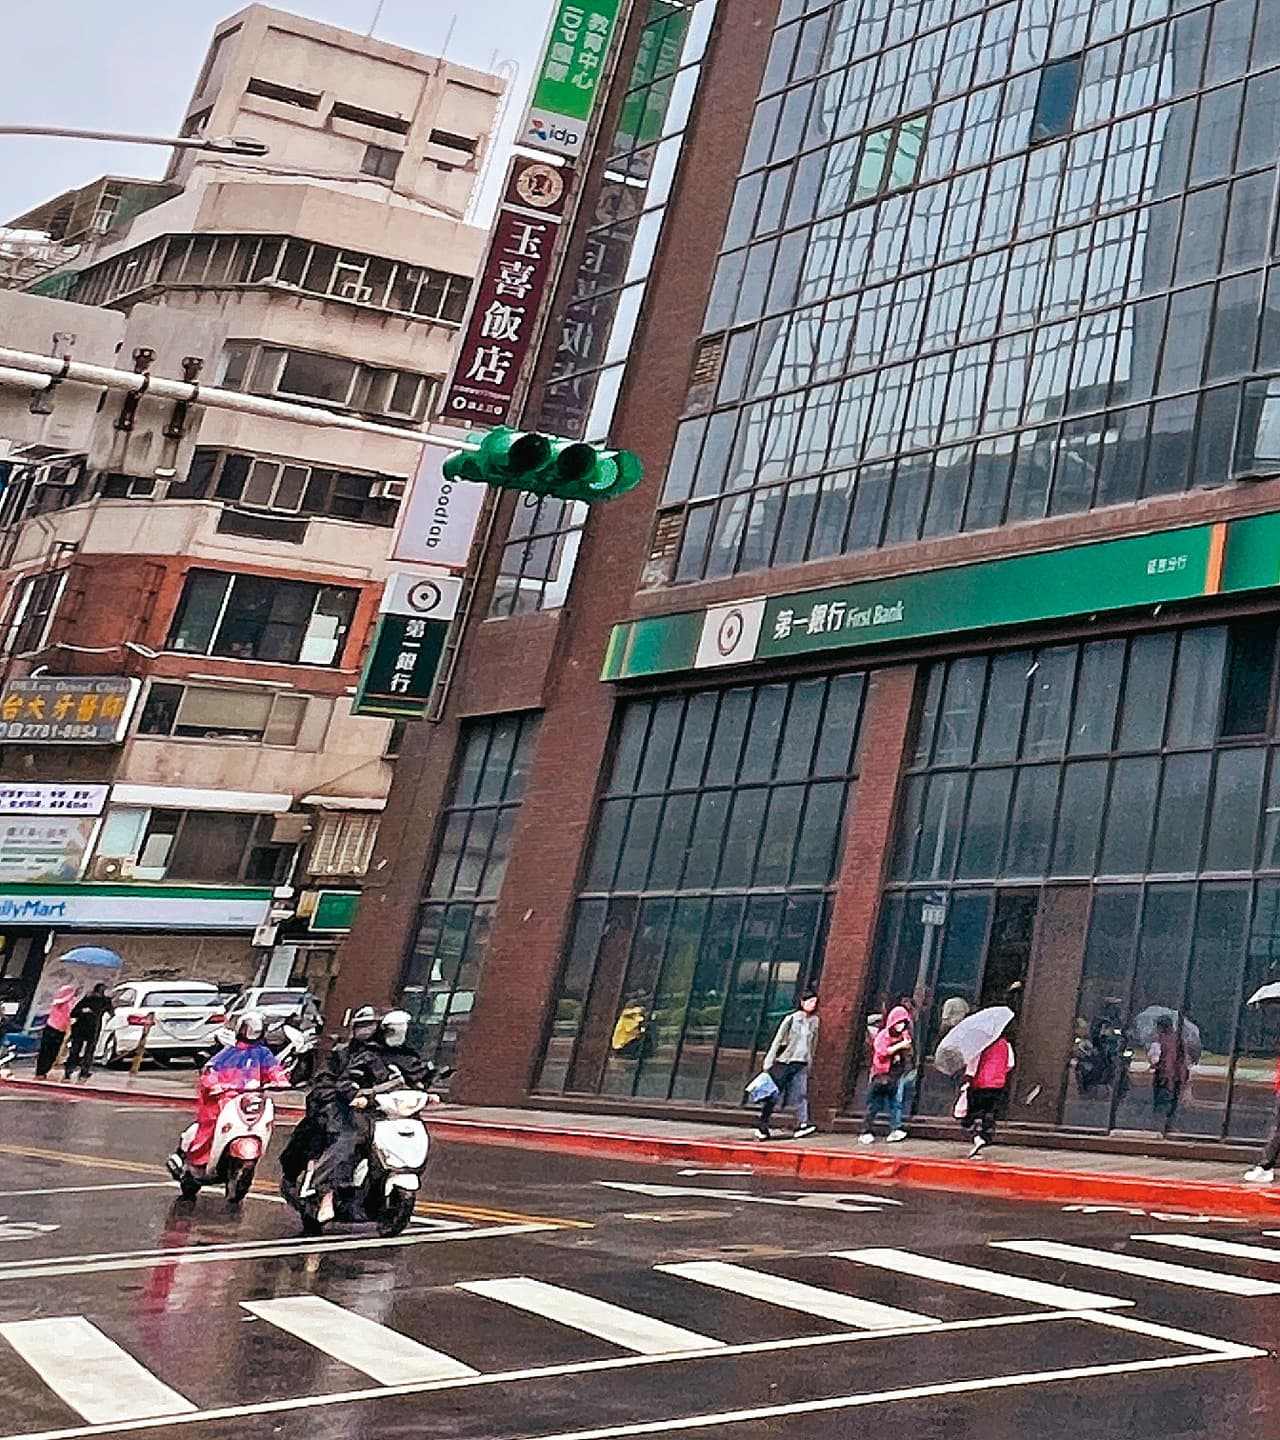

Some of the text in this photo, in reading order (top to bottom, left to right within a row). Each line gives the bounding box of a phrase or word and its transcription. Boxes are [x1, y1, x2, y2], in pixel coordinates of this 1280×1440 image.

[549, 124, 579, 145] idp
[466, 221, 547, 386] 玉喜飯店
[425, 485, 454, 549] oodlab
[773, 601, 905, 640] 第一銀行 First Bank
[390, 619, 427, 693] 第一銀行
[0, 900, 66, 917] ilyMart
